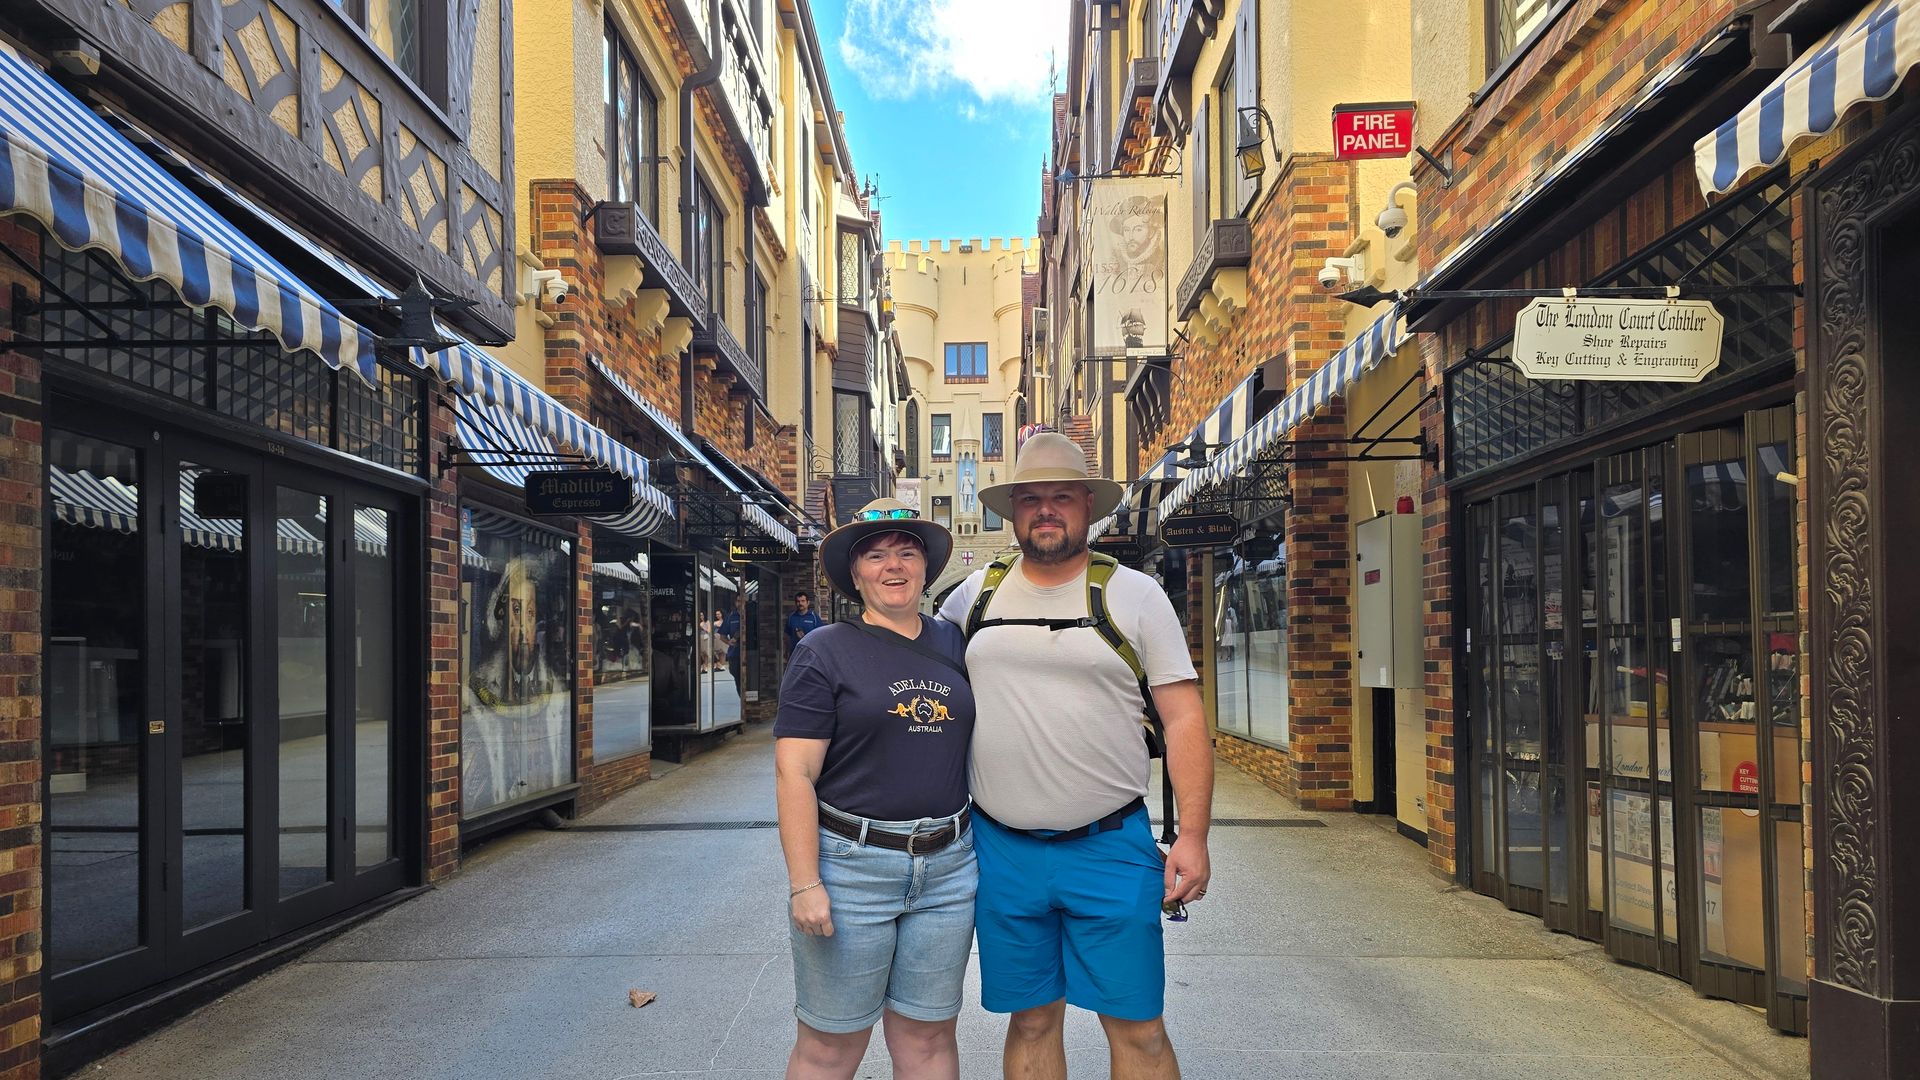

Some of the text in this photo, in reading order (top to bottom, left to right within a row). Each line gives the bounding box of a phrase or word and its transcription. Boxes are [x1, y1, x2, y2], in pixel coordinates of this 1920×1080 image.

[1353, 114, 1396, 131] FIRE
[1343, 133, 1406, 151] PANEL
[1097, 267, 1164, 295] 1618
[1536, 303, 1707, 332] The London Court Cobbler
[1582, 334, 1667, 350] Shoe Repairs
[1535, 351, 1699, 369] Key Cutting & Engraving
[540, 478, 614, 496] Madlilys
[552, 498, 601, 509] Espresso
[1166, 527, 1194, 536] Austen
[1208, 525, 1232, 533] Blake
[732, 545, 787, 554] MR. SHAVER
[888, 679, 951, 697] ADELAIDE
[908, 725, 943, 733] AUSTRALIA
[1613, 754, 1643, 775] London
[1739, 776, 1759, 784] CUTTIN
[1739, 784, 1759, 793] SERVIC
